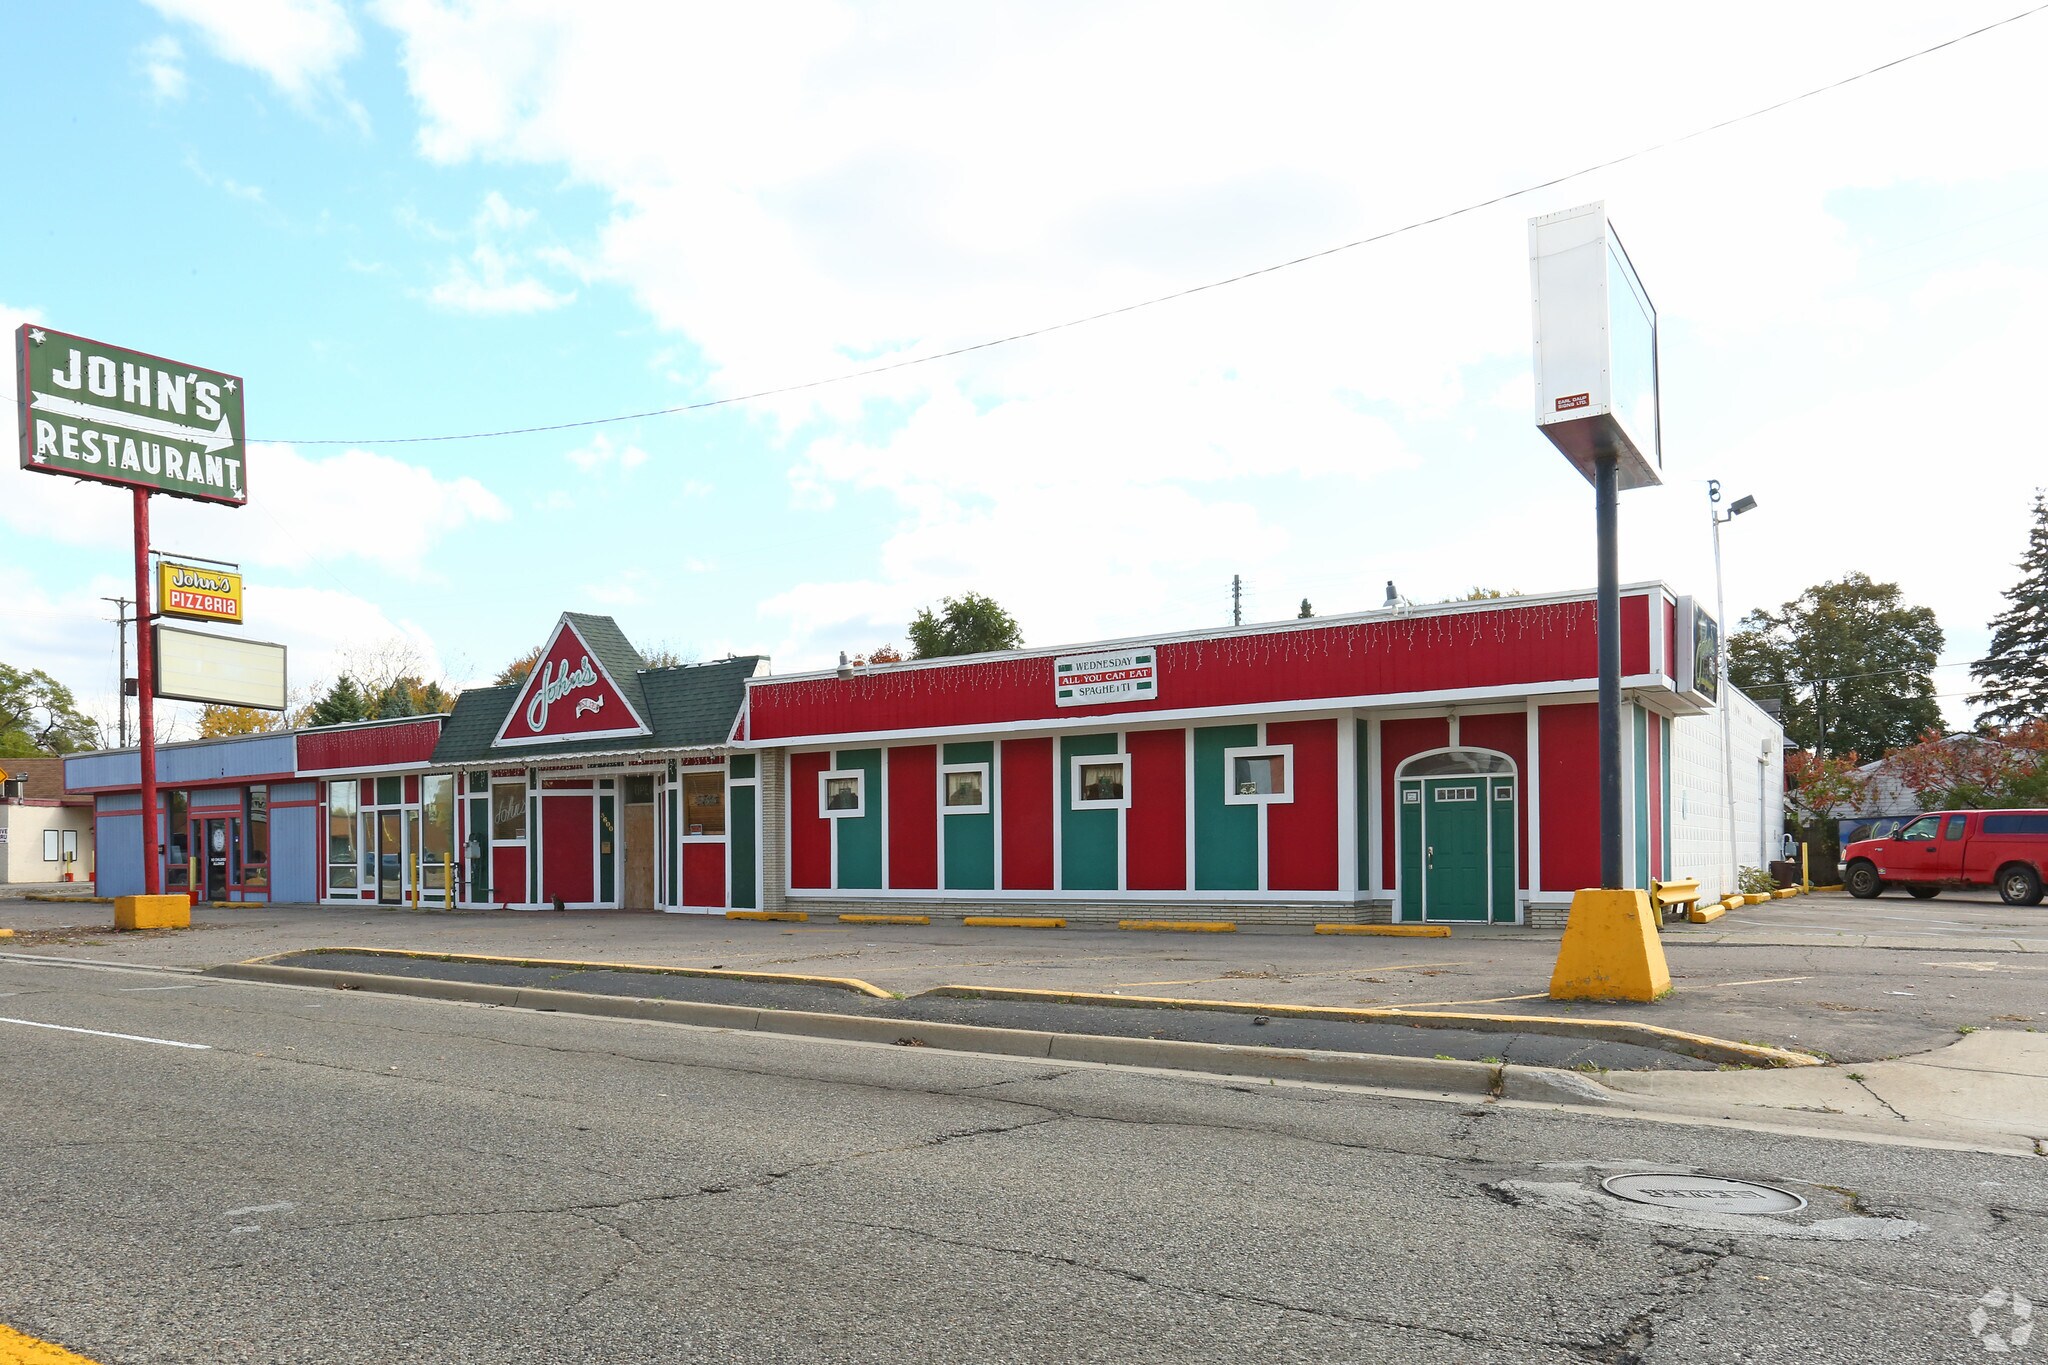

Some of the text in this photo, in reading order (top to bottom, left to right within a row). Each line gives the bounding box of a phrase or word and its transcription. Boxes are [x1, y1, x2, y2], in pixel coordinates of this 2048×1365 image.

[53, 349, 221, 421] JOHN'S
[36, 419, 241, 489] RESTAURANT
[172, 569, 231, 593] John's
[1076, 657, 1132, 670] WEDNESDAY
[1062, 669, 1148, 685] ALL YOU CAN EAT
